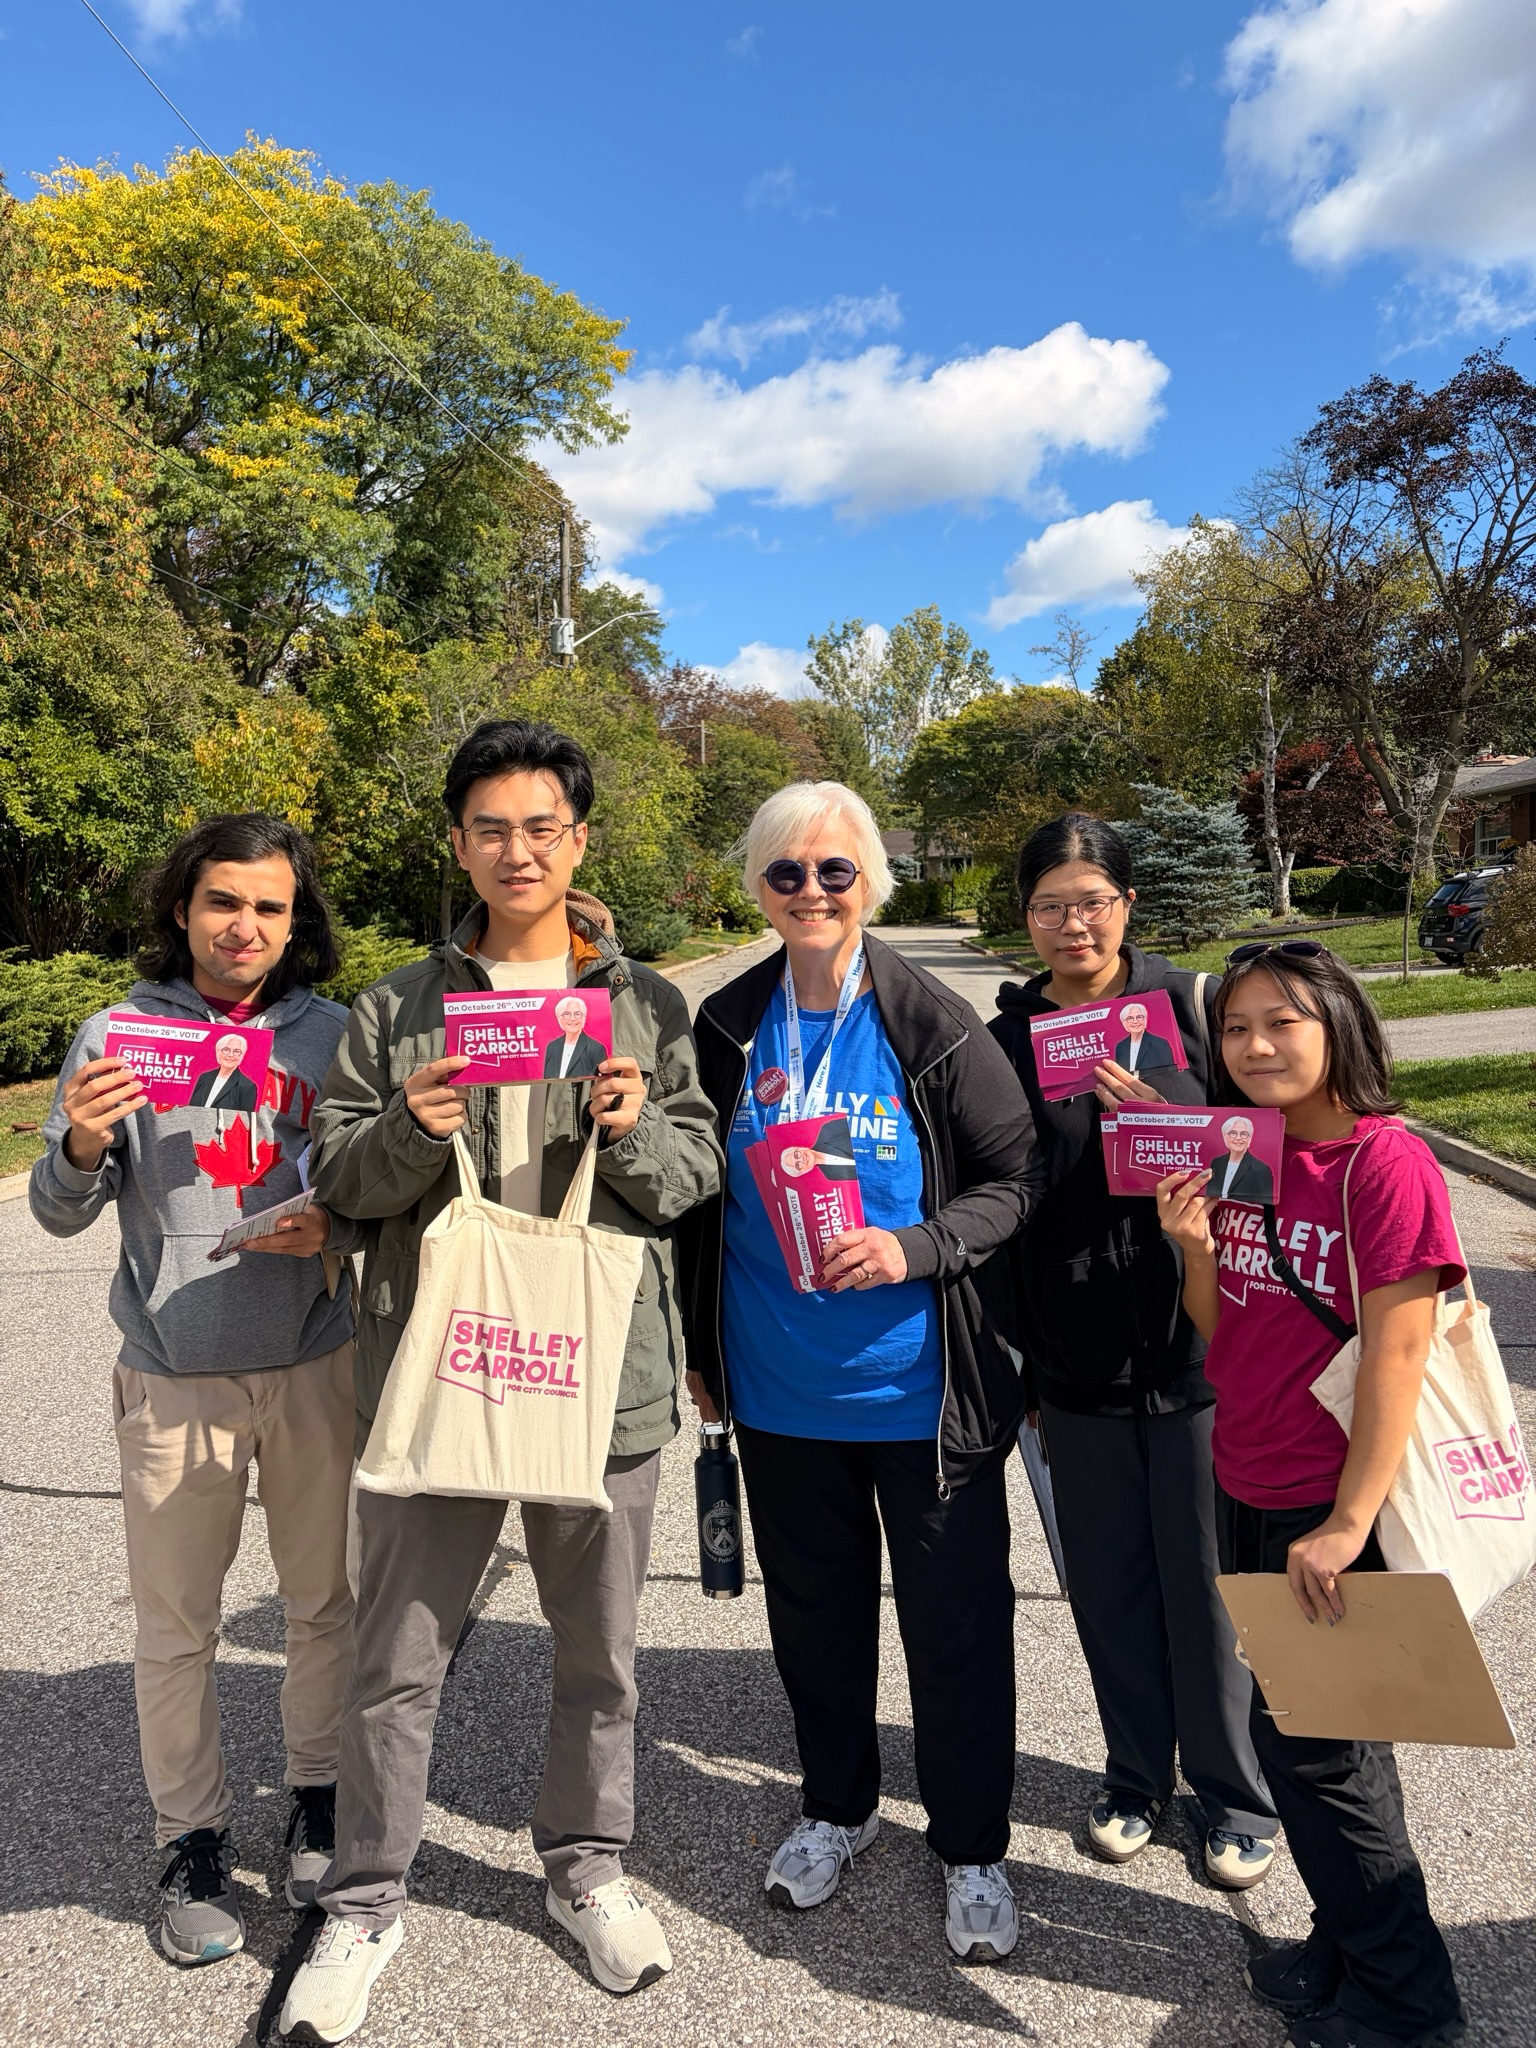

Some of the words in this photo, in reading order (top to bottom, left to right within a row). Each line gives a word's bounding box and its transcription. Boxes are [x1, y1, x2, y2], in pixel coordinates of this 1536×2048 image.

[447, 1005, 460, 1013] On
[461, 1003, 495, 1011] October
[1043, 1019, 1070, 1029] October
[1085, 1011, 1104, 1020] VOTE
[125, 1025, 159, 1035] October
[179, 1031, 201, 1039] VOTE
[464, 1025, 536, 1042] SHELLEY
[464, 1040, 539, 1056] CARROLL
[1047, 1031, 1106, 1052] SHELLEY
[122, 1049, 195, 1067] SHELLEY
[1049, 1043, 1110, 1063] CARROLL
[758, 1070, 781, 1093] SHELLEY
[1123, 1115, 1133, 1123] On
[1134, 1116, 1164, 1124] October
[1183, 1117, 1204, 1125] VOTE
[1135, 1139, 1202, 1153] SHELLEY
[1135, 1152, 1204, 1167] CARROLL
[790, 1194, 799, 1215] VOTE
[826, 1187, 844, 1235] RROLL
[813, 1192, 833, 1249] HELLEY
[798, 1232, 809, 1262] October
[806, 1262, 812, 1273] On
[1249, 1280, 1266, 1291] FOR
[1266, 1283, 1288, 1296] CITY
[453, 1320, 583, 1360] SHELLEY
[449, 1348, 581, 1388] CARROLL
[507, 1383, 522, 1393] FOR
[523, 1386, 542, 1395] CITY
[544, 1388, 578, 1399] COUNCIL
